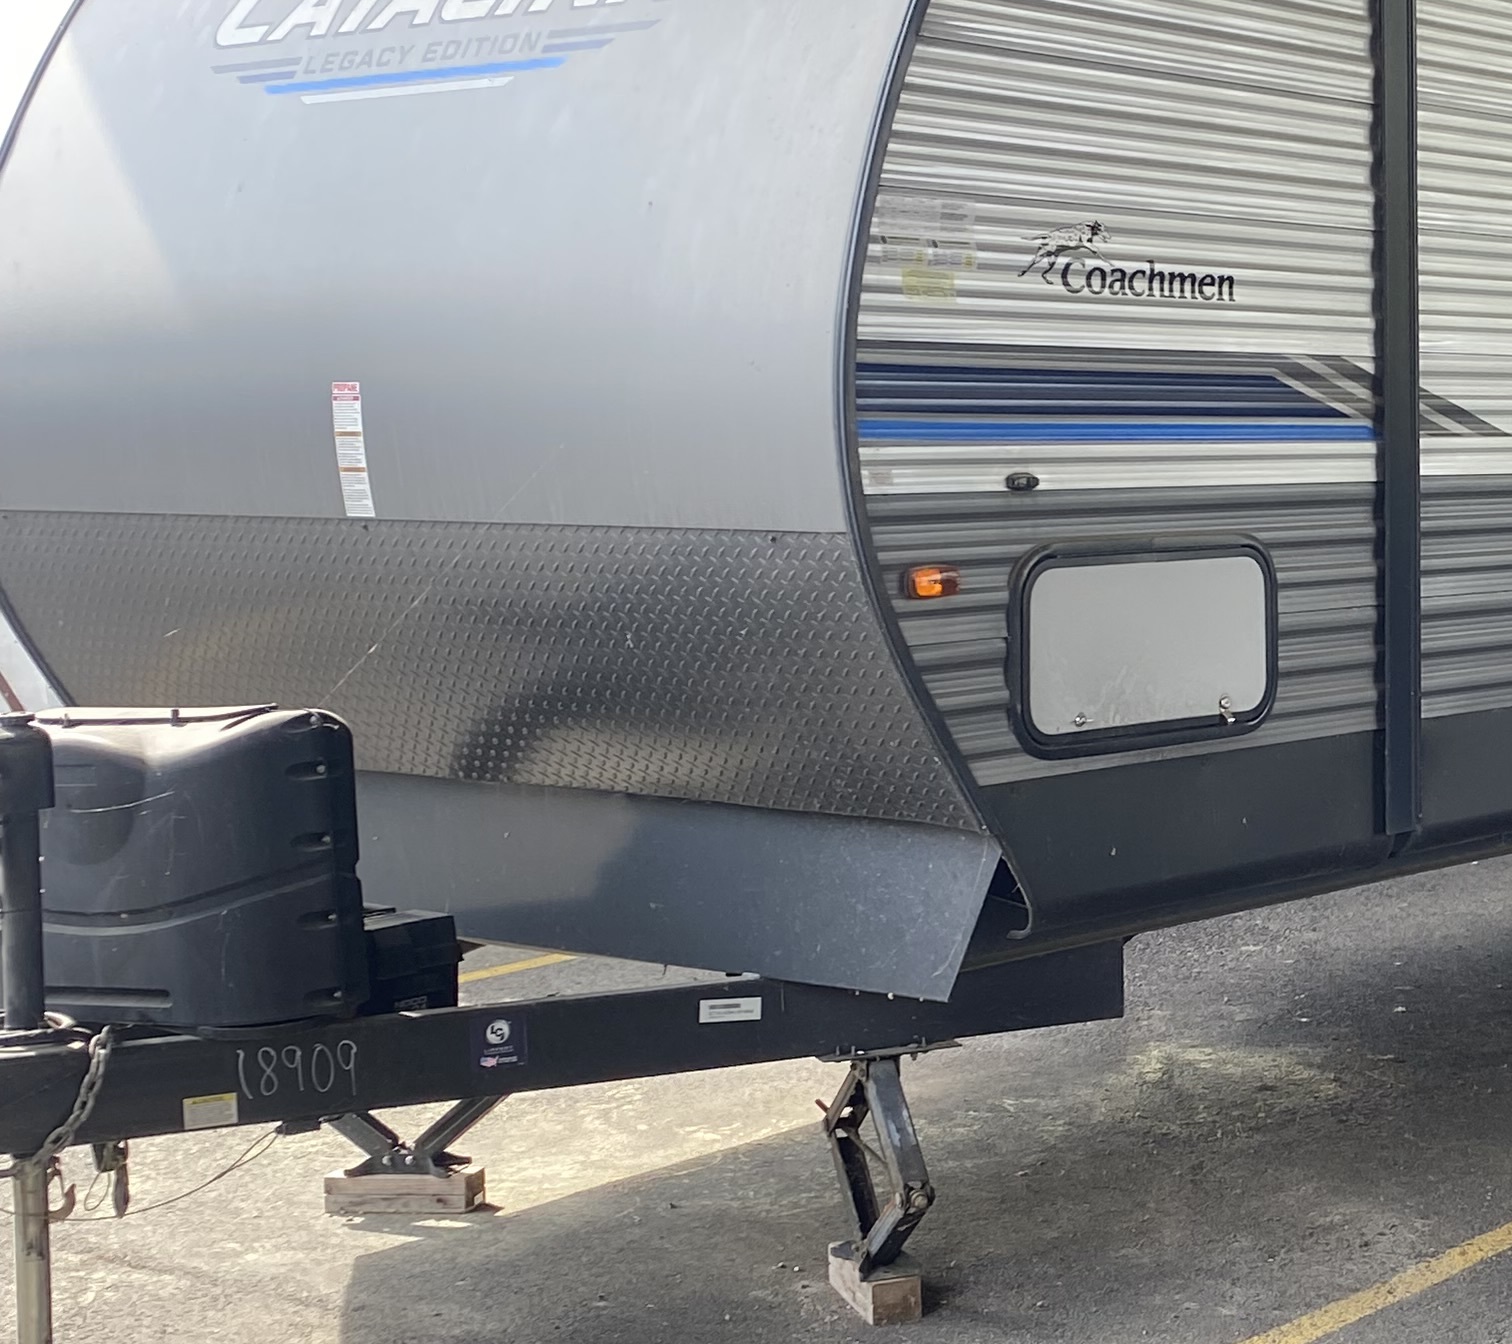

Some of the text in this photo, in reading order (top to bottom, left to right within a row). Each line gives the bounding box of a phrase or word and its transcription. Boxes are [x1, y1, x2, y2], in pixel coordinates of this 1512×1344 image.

[303, 31, 542, 75] LEGACY EDITION
[1059, 257, 1236, 302] Coachmen
[236, 1040, 358, 1100] 18909
